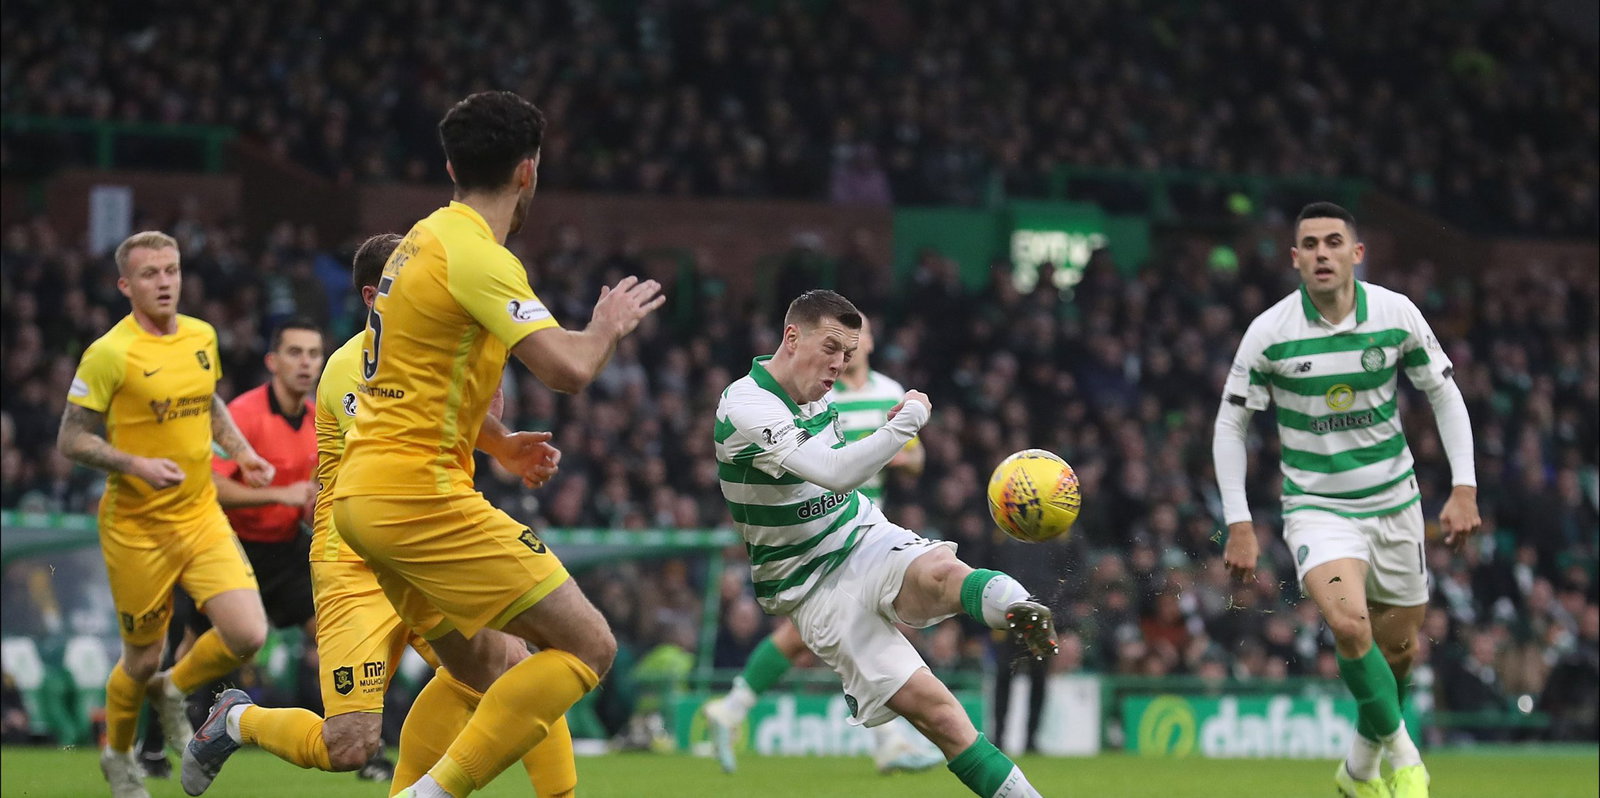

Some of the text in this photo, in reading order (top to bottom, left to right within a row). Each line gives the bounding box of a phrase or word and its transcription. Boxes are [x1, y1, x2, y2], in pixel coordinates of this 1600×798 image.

[362, 275, 396, 381] 5
[1310, 411, 1374, 433] dafabet
[798, 489, 853, 519] dafab
[1201, 695, 1352, 758] dafab
